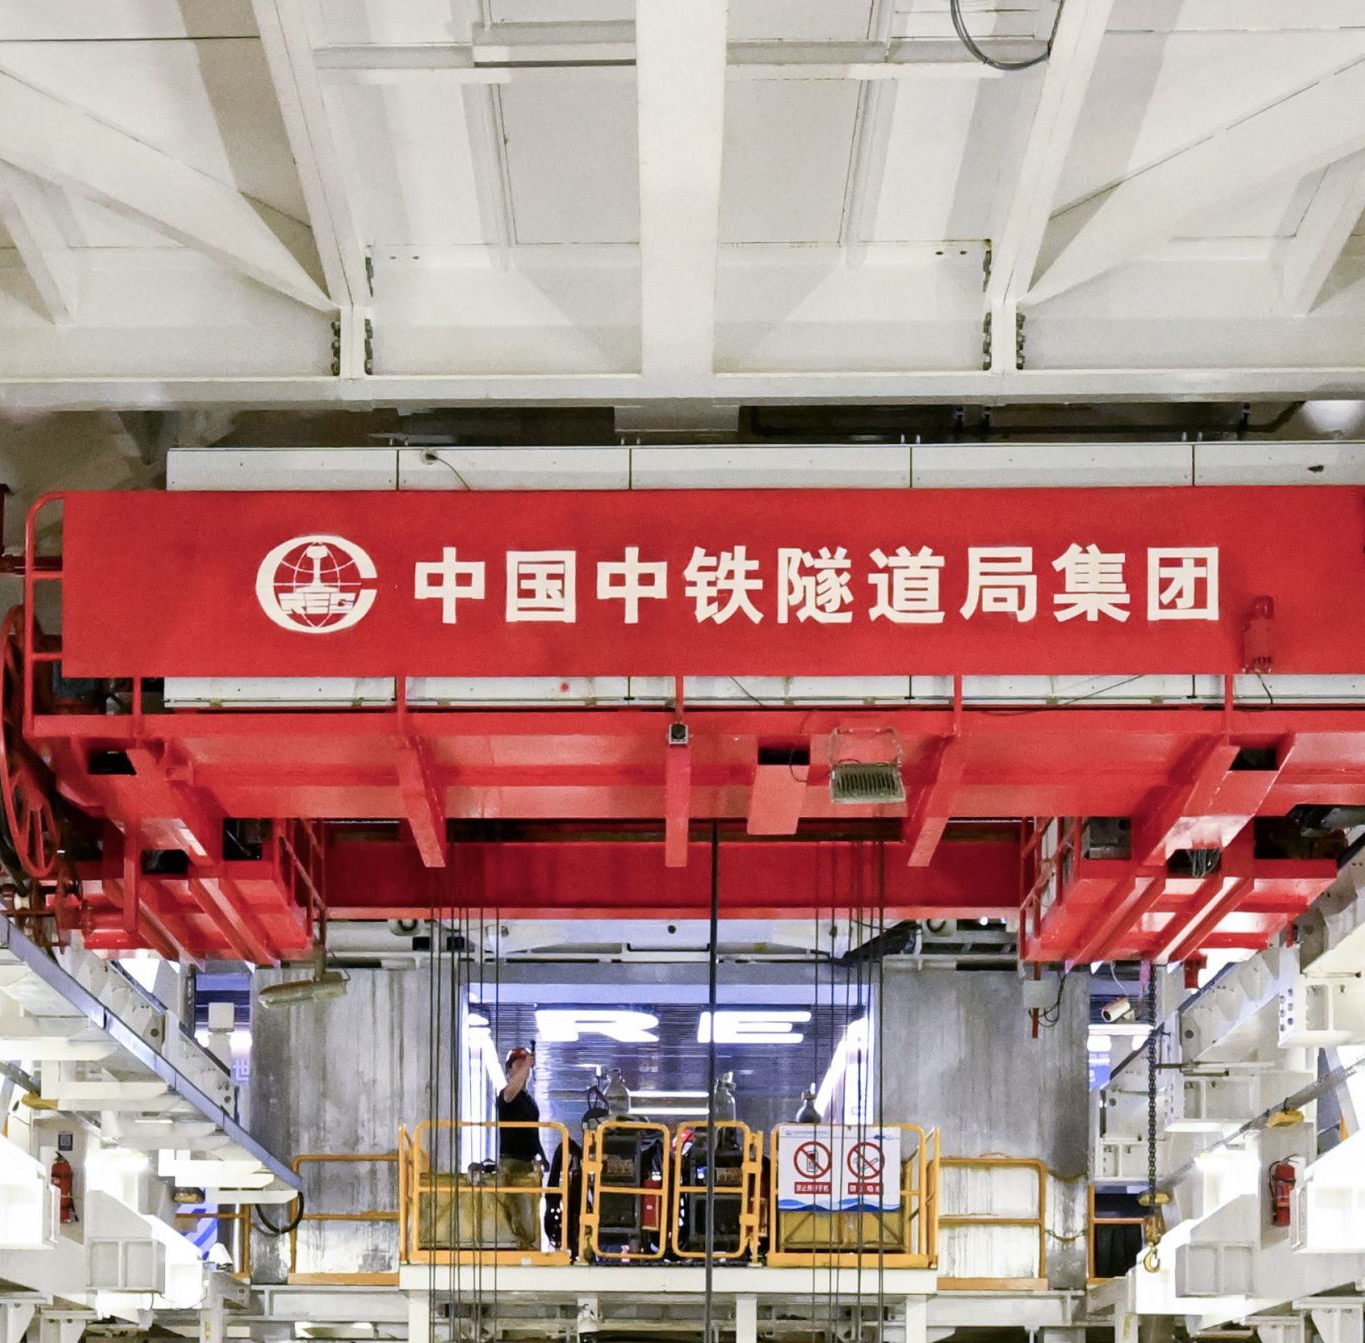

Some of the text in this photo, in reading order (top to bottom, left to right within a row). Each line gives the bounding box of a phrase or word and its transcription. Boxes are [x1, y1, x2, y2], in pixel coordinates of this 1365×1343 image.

[415, 543, 1220, 625] 中国中铁隧道局集团
